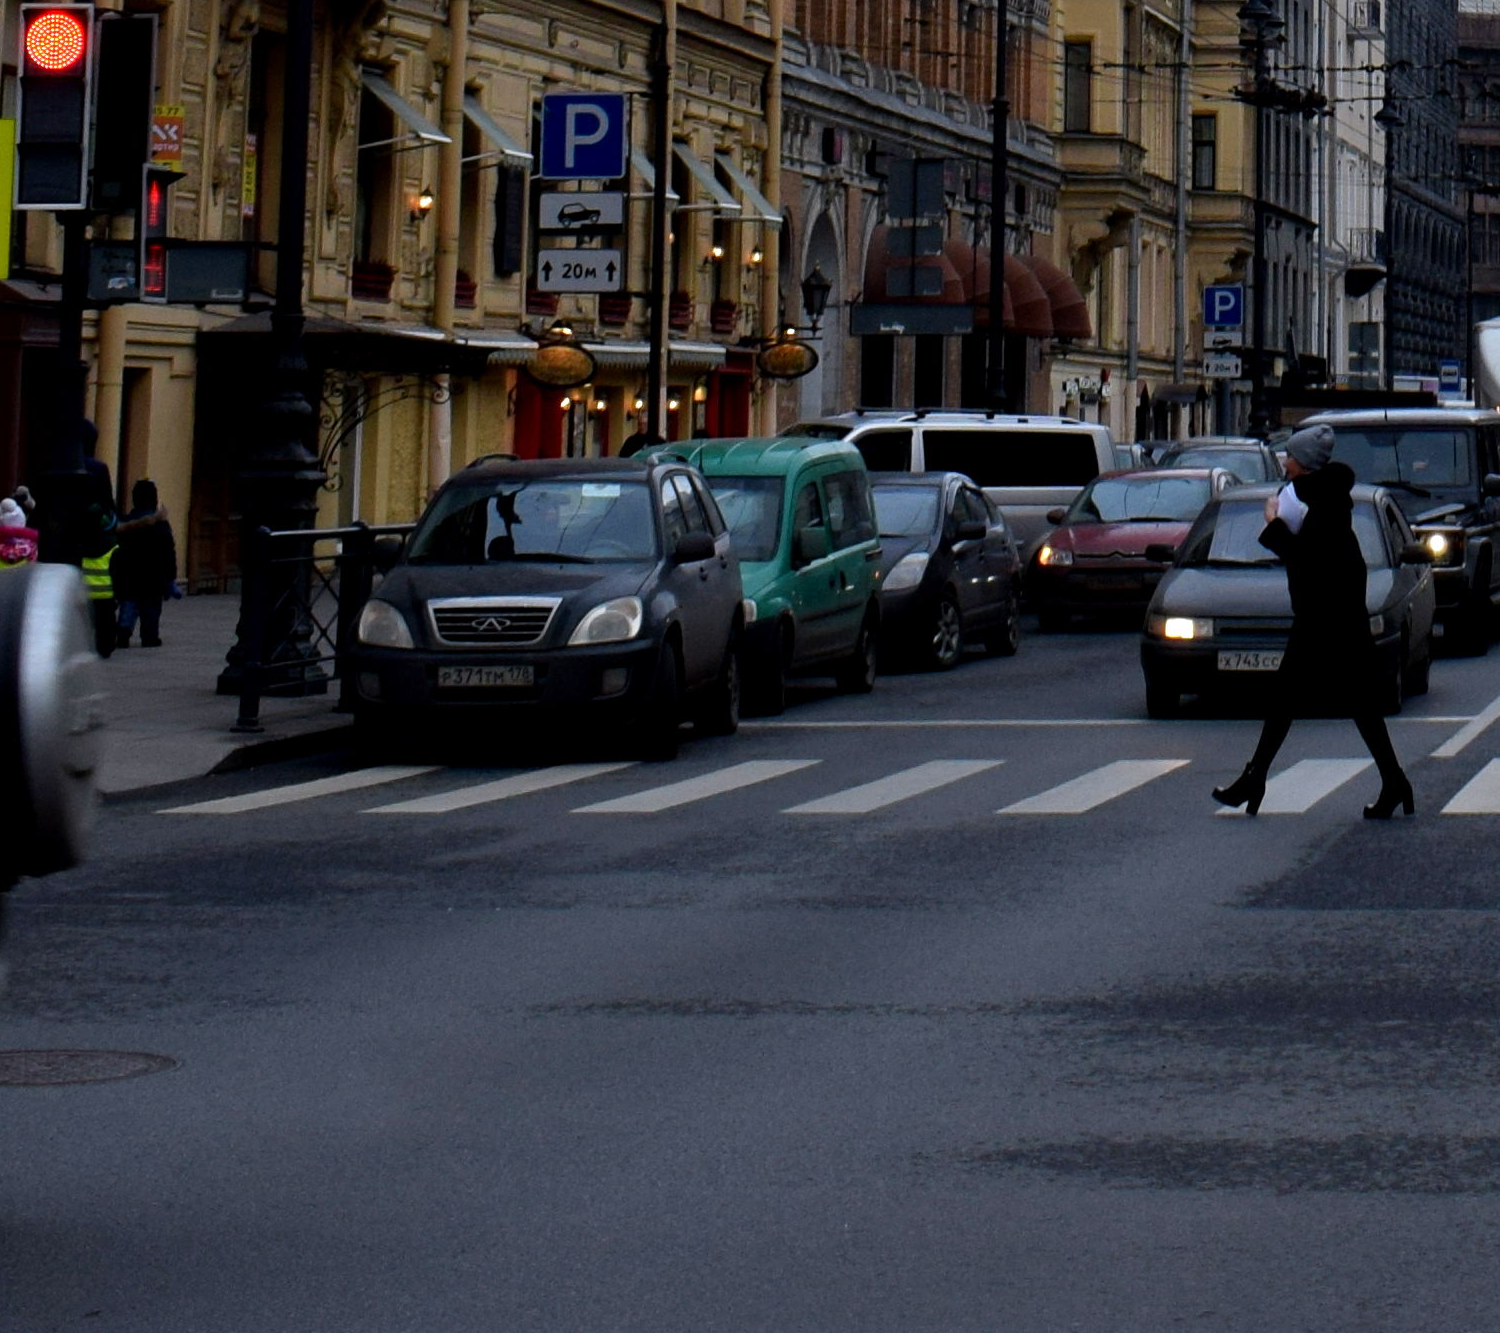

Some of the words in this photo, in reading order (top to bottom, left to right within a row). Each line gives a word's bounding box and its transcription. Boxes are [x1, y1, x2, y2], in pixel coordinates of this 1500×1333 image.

[166, 107, 180, 116] 77
[564, 102, 610, 170] P
[562, 262, 597, 282] 20м
[1214, 290, 1236, 322] P
